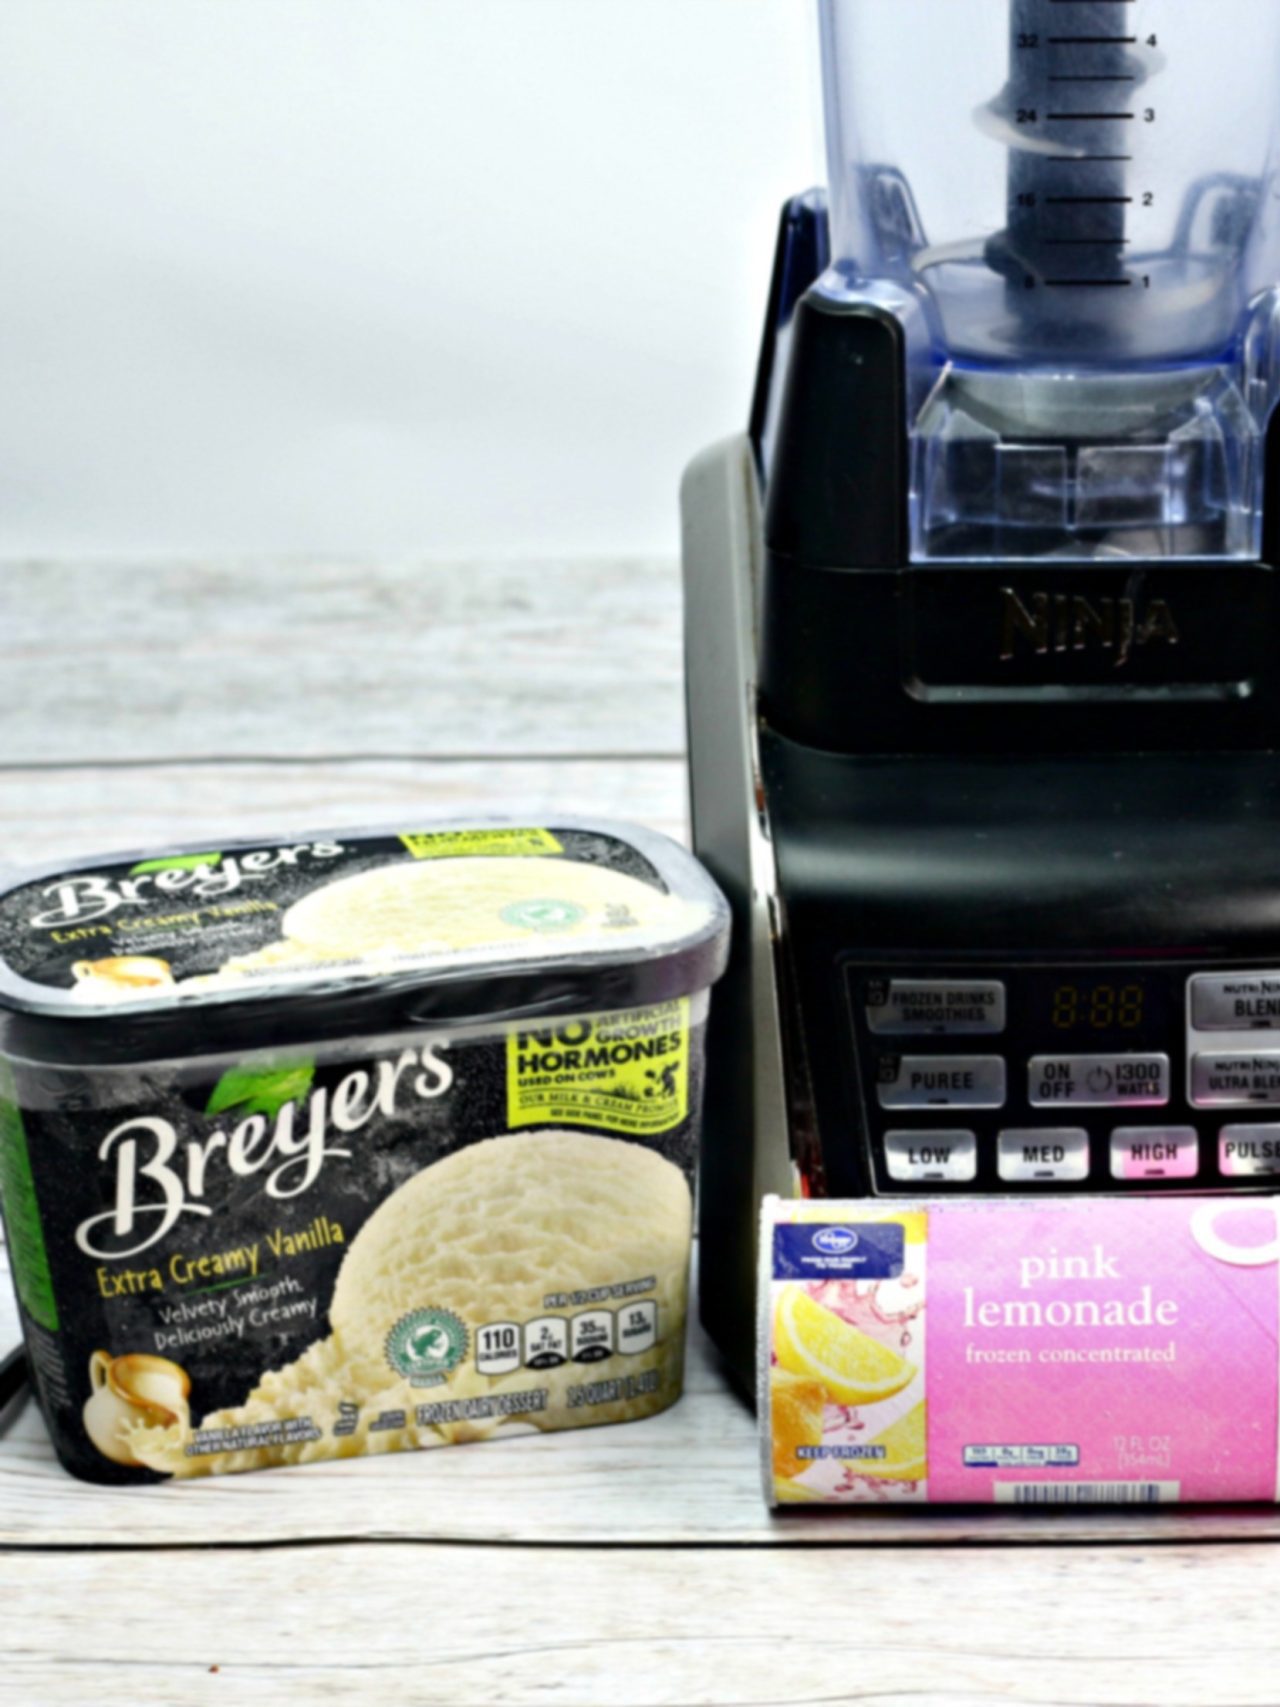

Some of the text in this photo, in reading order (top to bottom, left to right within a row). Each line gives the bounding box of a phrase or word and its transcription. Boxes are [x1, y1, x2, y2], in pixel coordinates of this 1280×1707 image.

[1018, 33, 1157, 48] 32 4
[1016, 109, 1155, 123] 24 3
[1142, 193, 1153, 207] 2
[1142, 276, 1150, 289] 1
[1000, 587, 1178, 667] NINJA
[31, 840, 346, 928] Breyers
[51, 926, 112, 944] Extra
[117, 906, 200, 933] Creamy
[206, 899, 279, 920] Vanilla
[892, 991, 943, 1006] FROZEN
[948, 991, 995, 1006] DRINKS
[596, 1000, 681, 1027] ARTIFICIAL
[902, 1007, 985, 1021] SMOOTHIES
[518, 1018, 592, 1049] NO
[596, 1015, 681, 1044] GROWTH
[517, 1031, 681, 1074] HORMONES
[518, 1069, 616, 1087] USED ON COWS
[911, 1071, 974, 1090] PUREE
[1044, 1063, 1160, 1080] ON 1300
[1039, 1081, 1160, 1099] OFF WATTS
[1208, 1076, 1248, 1090] ULTRA
[74, 1037, 453, 1259] Breyers
[908, 1146, 951, 1165] LOW
[1022, 1145, 1065, 1163] MED
[1131, 1143, 1179, 1161] HIGH
[96, 1216, 345, 1298] Extra Creamy Vanilla
[1020, 1245, 1121, 1289] pink
[158, 1297, 228, 1325] Velvety
[963, 1287, 1179, 1327] lemonade
[153, 1296, 319, 1351] Deliciously Creamy
[483, 1327, 515, 1351] 110
[965, 1343, 1176, 1364] frozen concentrated
[796, 1445, 886, 1460] KEEP FROZEN
[1149, 1435, 1171, 1452] OZ
